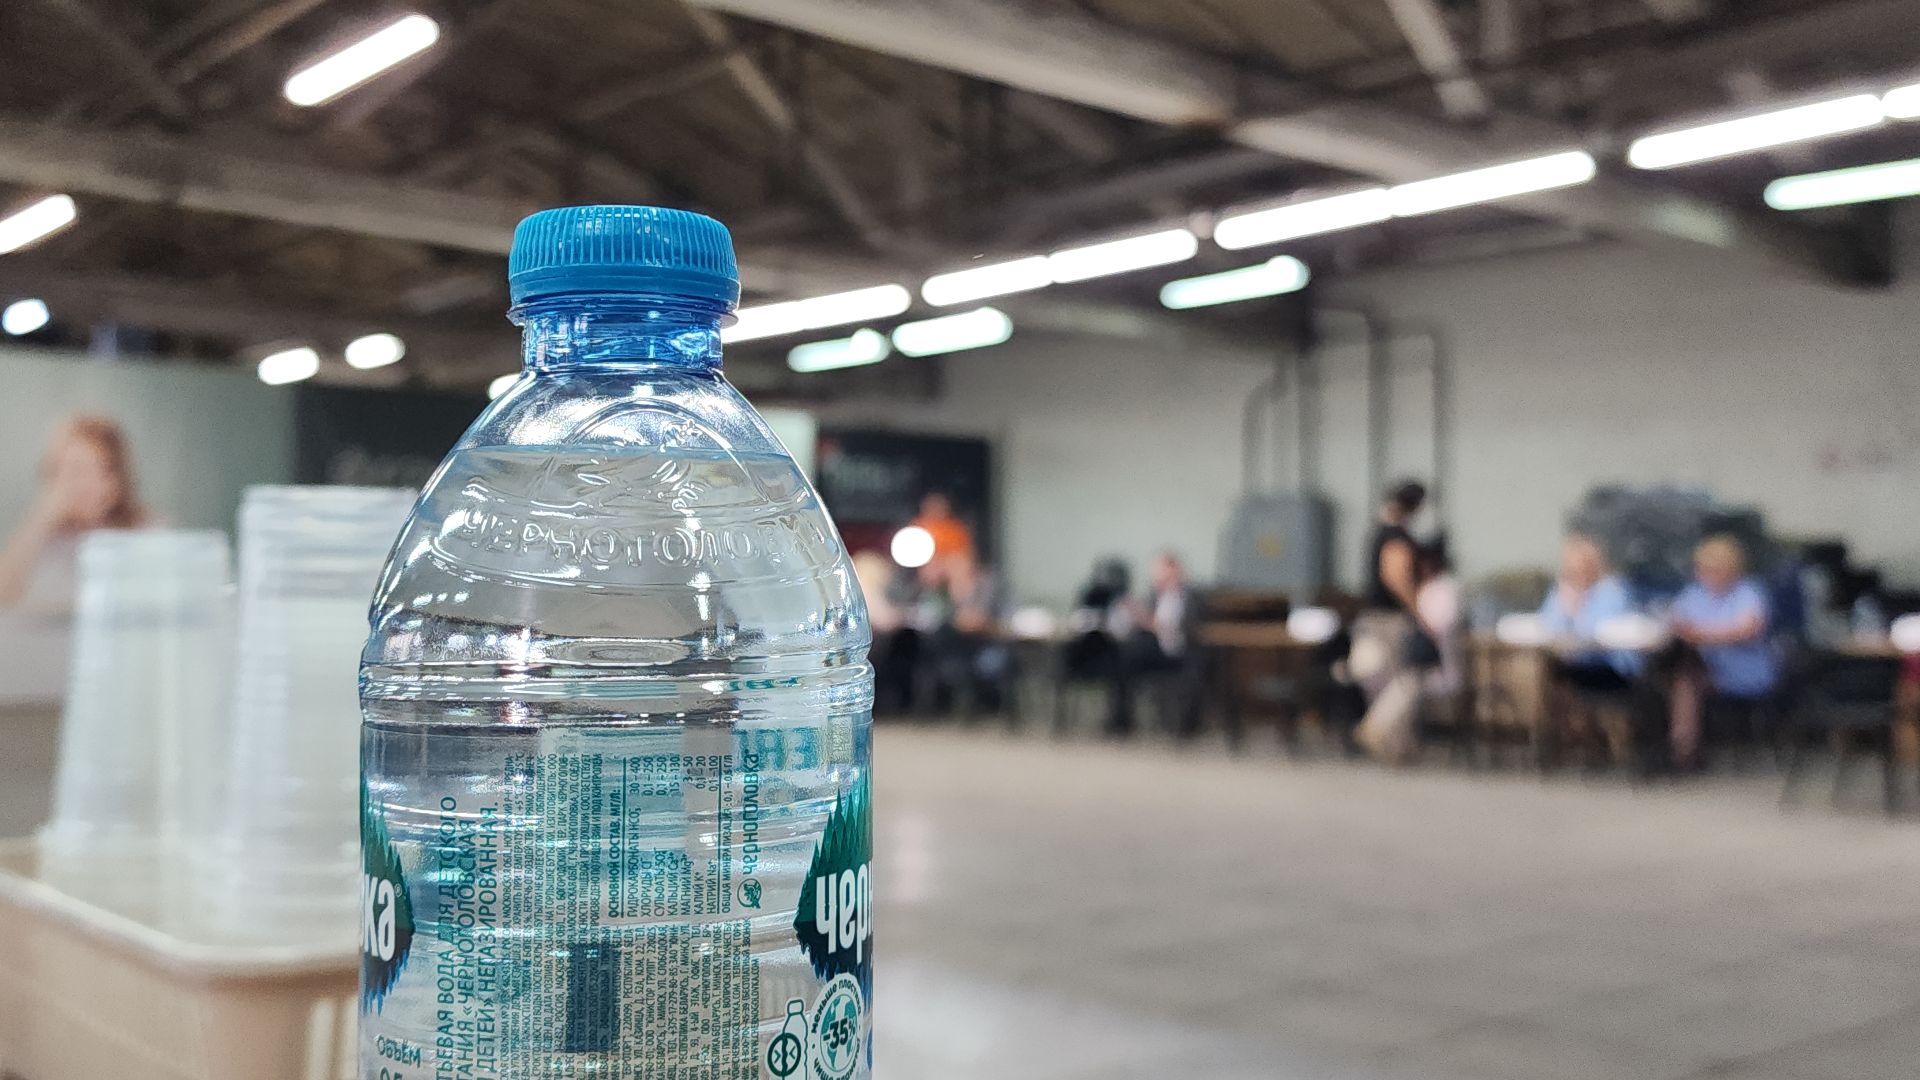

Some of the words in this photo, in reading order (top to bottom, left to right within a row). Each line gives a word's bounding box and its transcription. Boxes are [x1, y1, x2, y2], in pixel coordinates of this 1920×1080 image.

[630, 757, 640, 774] 400
[643, 756, 654, 773] 250
[657, 756, 667, 772] 250
[670, 756, 680, 772] 130
[683, 756, 693, 767] 50
[696, 756, 706, 767] 20
[610, 789, 622, 816] МГ/Л:
[630, 782, 640, 794] 30
[642, 784, 655, 796] 0,1
[656, 784, 668, 796] 0,1
[742, 754, 761, 874] черноголовка
[438, 797, 456, 899] ДЕТСКОГО
[610, 818, 622, 860] СОСТАВ,
[607, 862, 620, 918] ОСНОВНОЙ
[627, 832, 640, 917] ГИДРОКАРБОНАТЫ
[640, 872, 653, 916] ХЛОРИДЫ
[654, 869, 665, 916] СУЛЬФАТЫ
[478, 802, 498, 992] НЕГАЗИРОВАННАЯ.
[666, 873, 680, 916] КАЛЬЦИЙ
[680, 876, 691, 916] МАГНИЙ
[692, 884, 704, 914] КАЛИЙ
[705, 879, 717, 914] НАТРИЙ
[722, 884, 732, 913] ОБЩАЯ
[438, 905, 456, 944] ДЛЯ
[457, 820, 476, 1015] «ЧЕРНОГОЛОВСКАЯ
[437, 950, 456, 1004] ВОДА
[436, 1010, 454, 1080] ТЬЕВАЯ
[474, 998, 496, 1072] ДЕТЕЙ»
[823, 1018, 856, 1050] -35%
